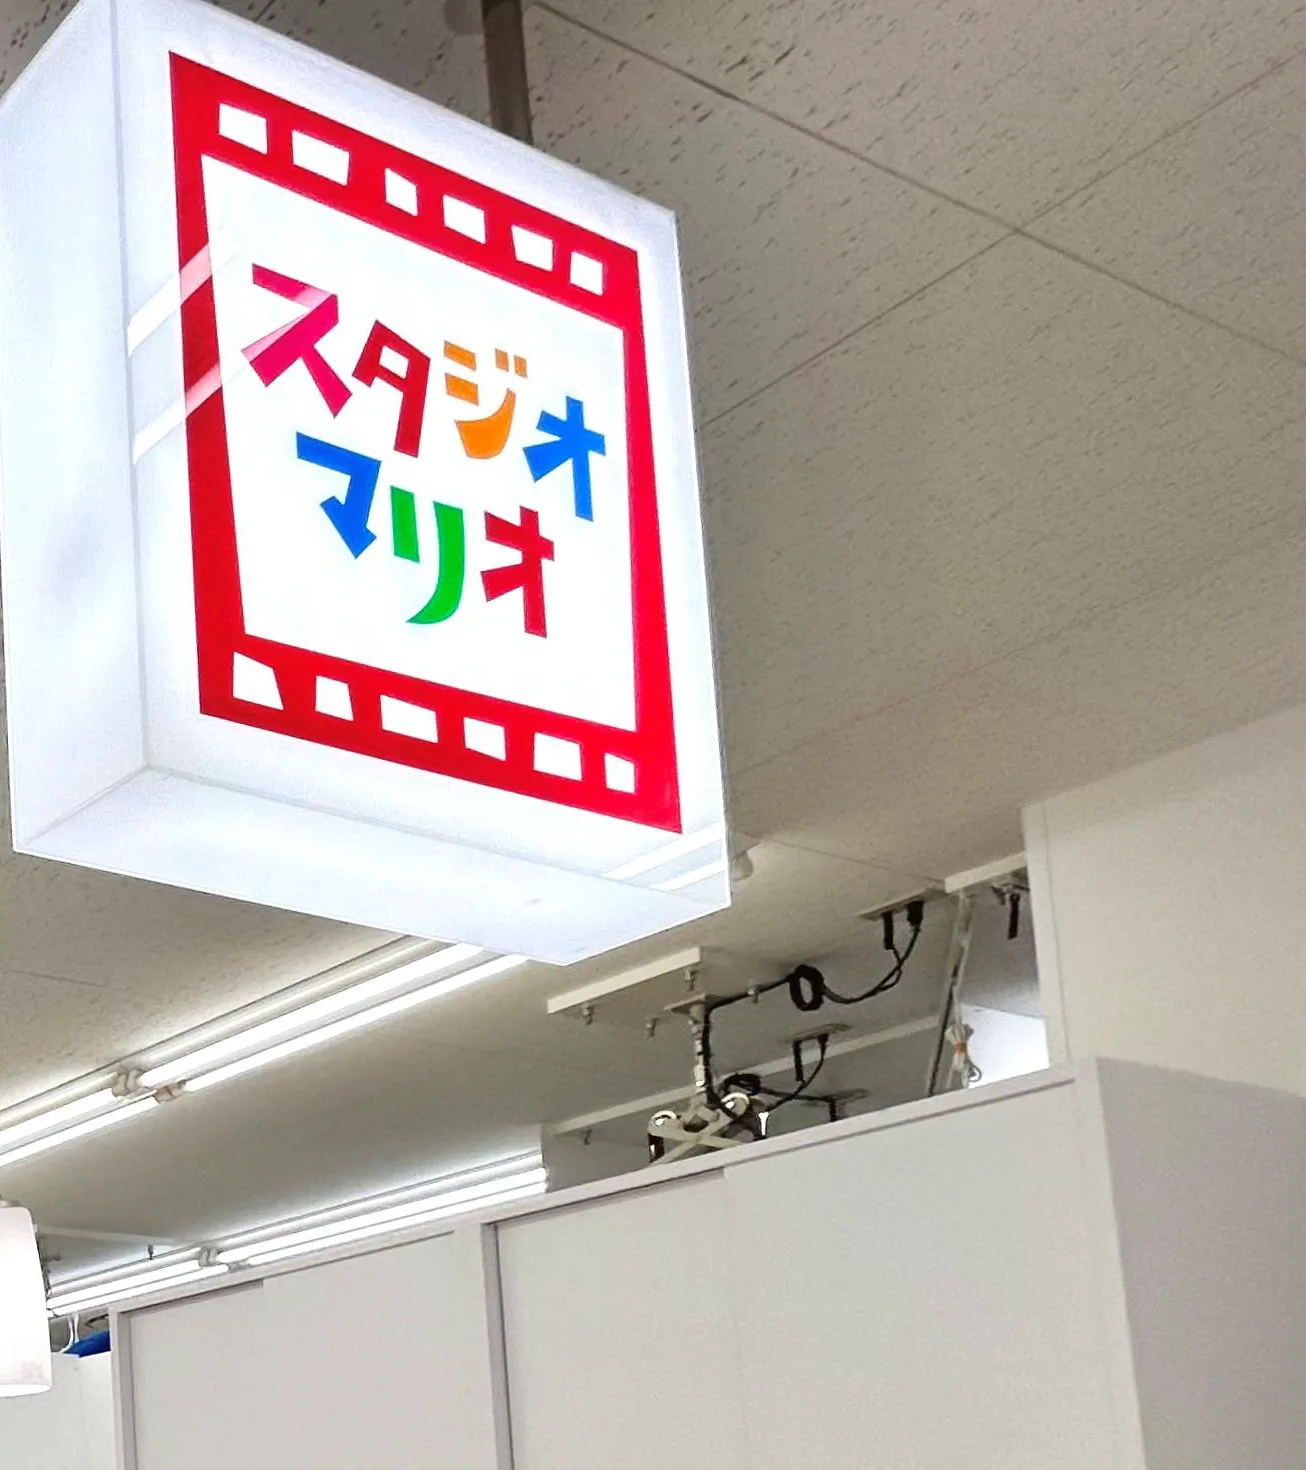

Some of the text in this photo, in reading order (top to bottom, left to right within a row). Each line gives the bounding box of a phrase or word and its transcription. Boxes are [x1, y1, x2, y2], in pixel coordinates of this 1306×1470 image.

[241, 263, 606, 521] スタジオ
[296, 431, 555, 640] マリオ
